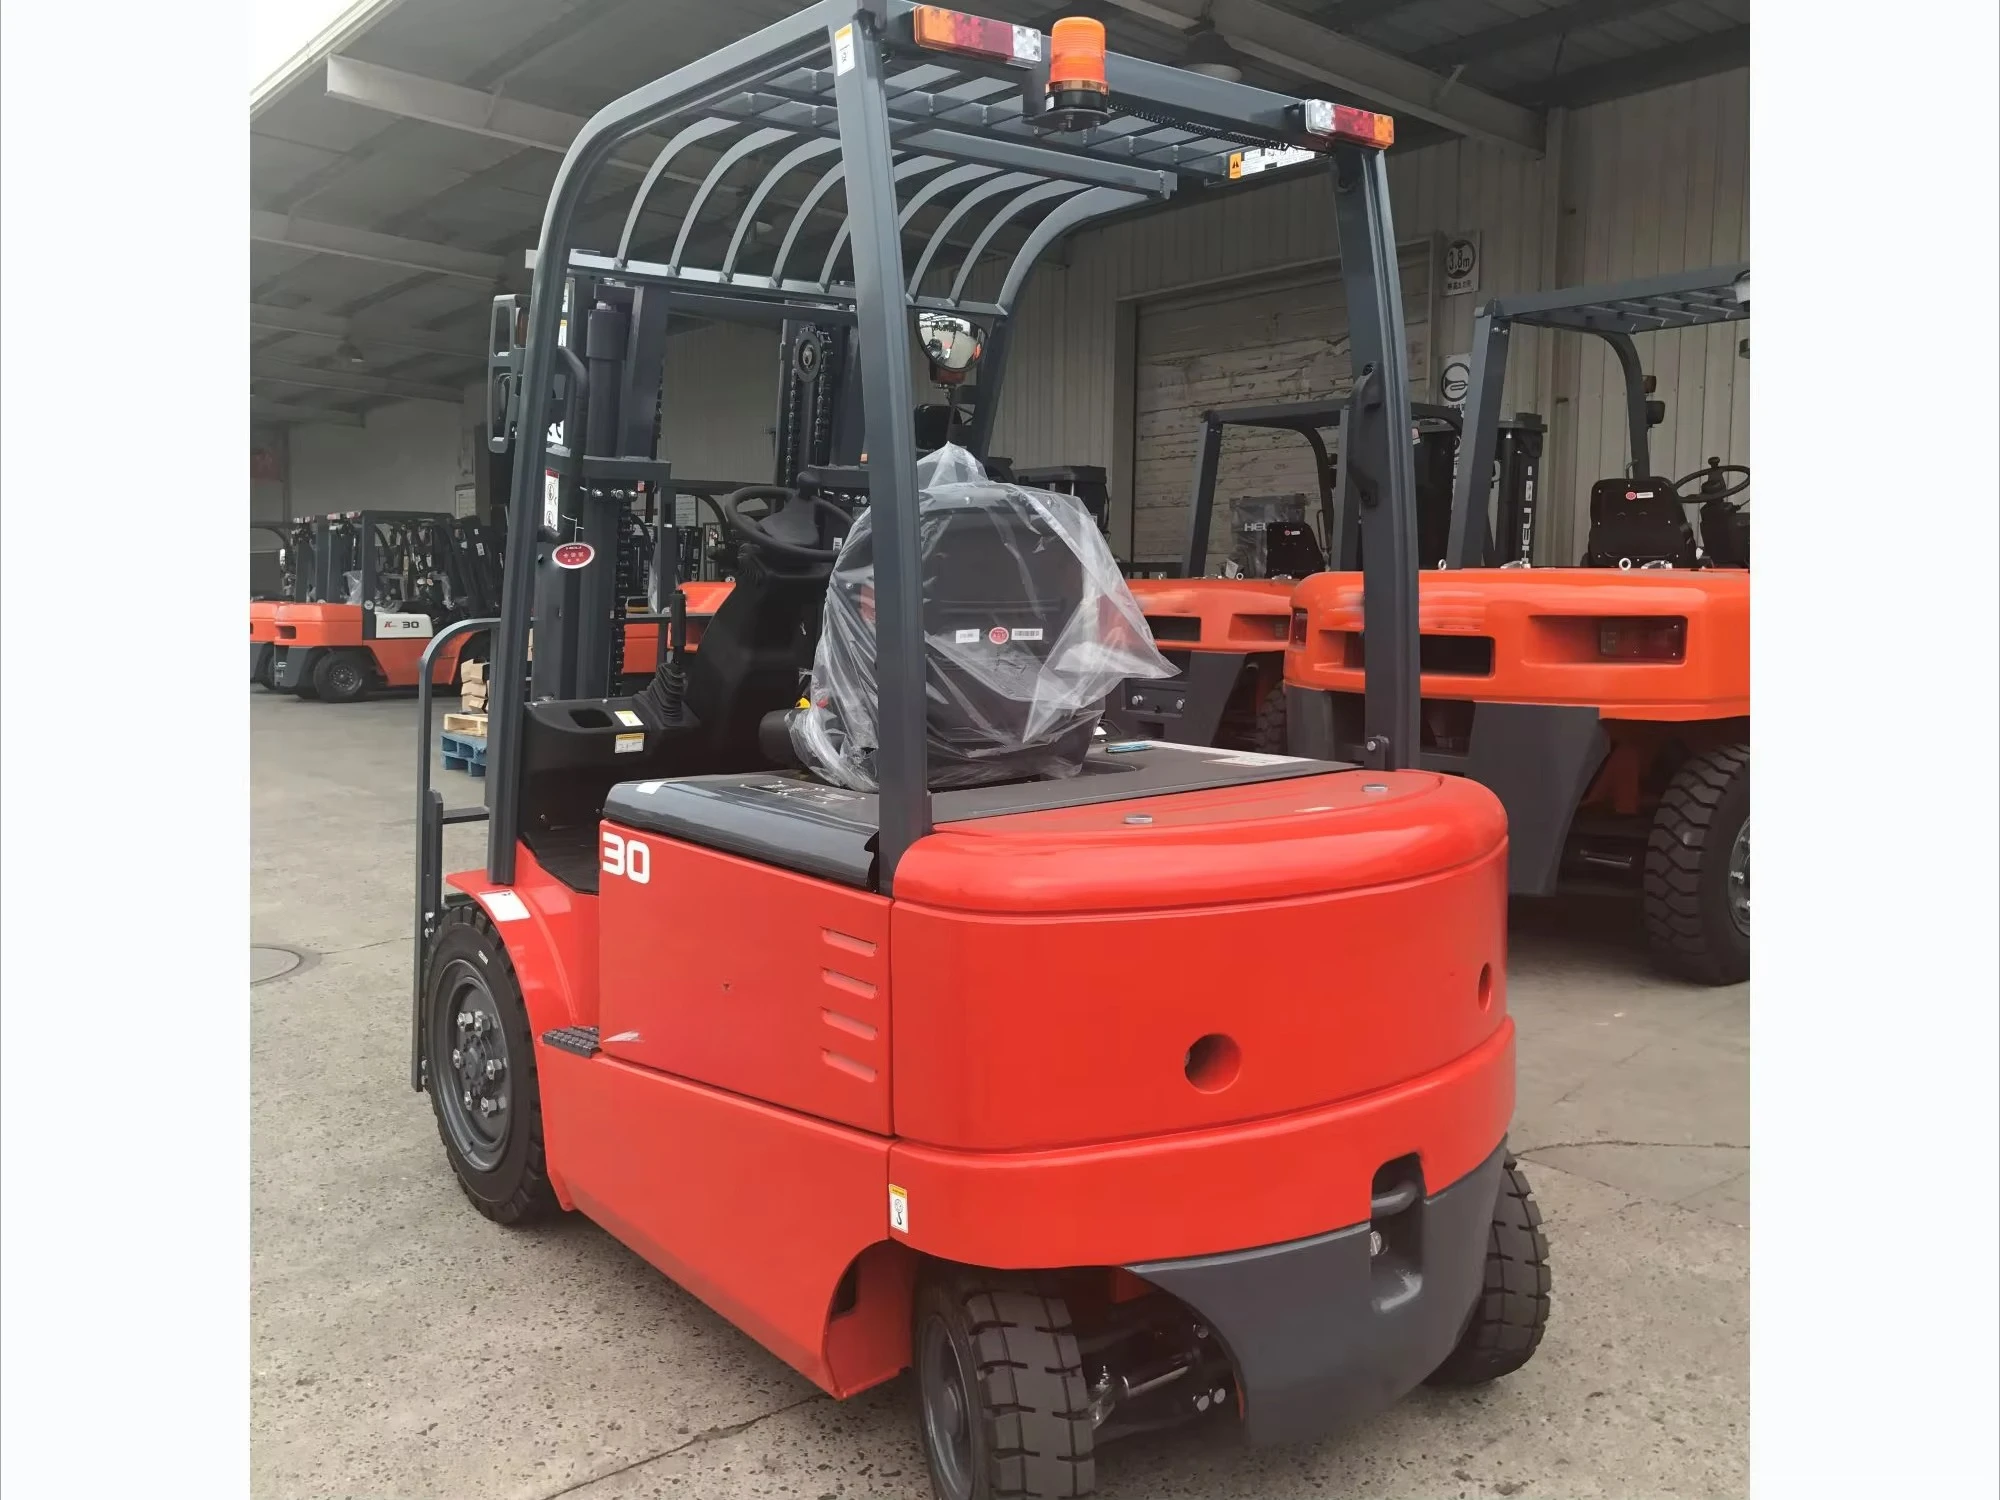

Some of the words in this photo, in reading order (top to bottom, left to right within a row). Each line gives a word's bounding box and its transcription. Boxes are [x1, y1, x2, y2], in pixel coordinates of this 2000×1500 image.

[1244, 522, 1267, 532] HEL
[1521, 507, 1532, 564] HELI
[402, 621, 420, 629] 30
[602, 831, 650, 885] 30
